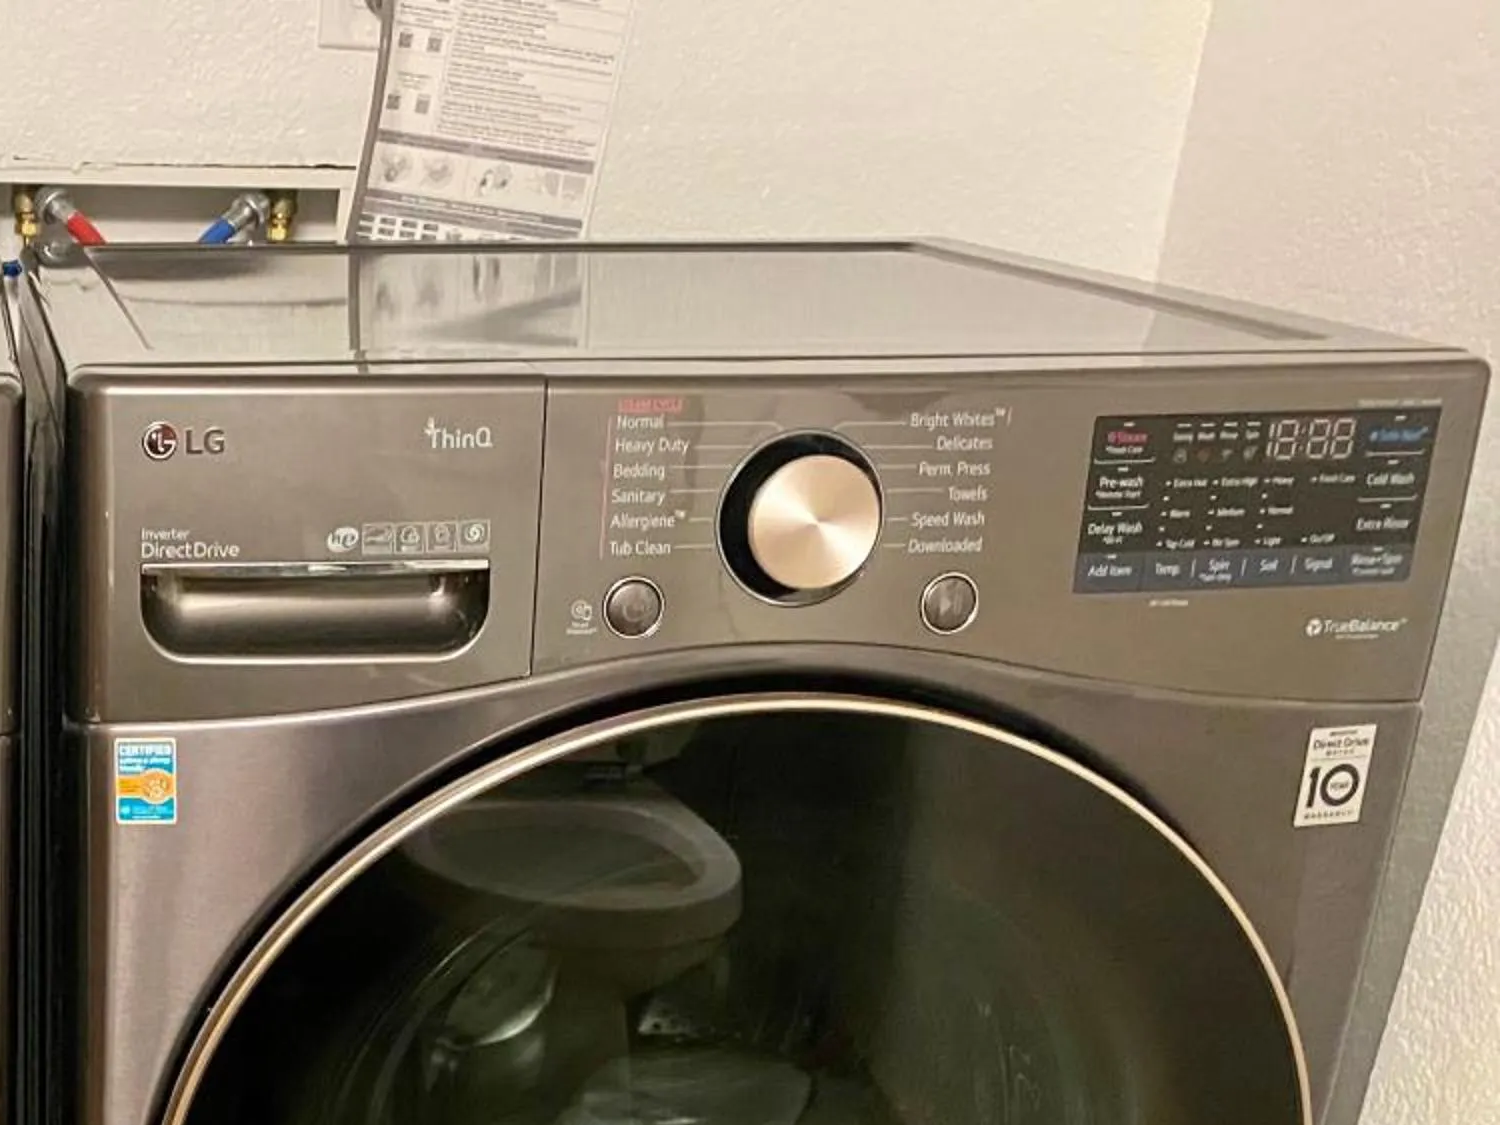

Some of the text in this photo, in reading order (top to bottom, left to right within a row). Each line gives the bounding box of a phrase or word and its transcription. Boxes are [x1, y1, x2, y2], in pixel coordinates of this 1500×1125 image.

[616, 414, 665, 430] Normal
[910, 411, 950, 431] Bright
[424, 417, 493, 449] ThinQ
[615, 436, 691, 456] Heavy Duty
[937, 434, 994, 451] Delicates
[612, 463, 666, 481] Bedding
[957, 460, 992, 476] Press
[611, 487, 666, 506] Sanitary
[948, 484, 989, 501] Towels
[911, 510, 986, 529] Speed Wash
[141, 527, 191, 541] Inverter
[610, 539, 671, 555] Tub Clean
[908, 535, 984, 553] Downloaded
[1313, 736, 1370, 751] Direct Drive
[1306, 763, 1360, 808] 10
